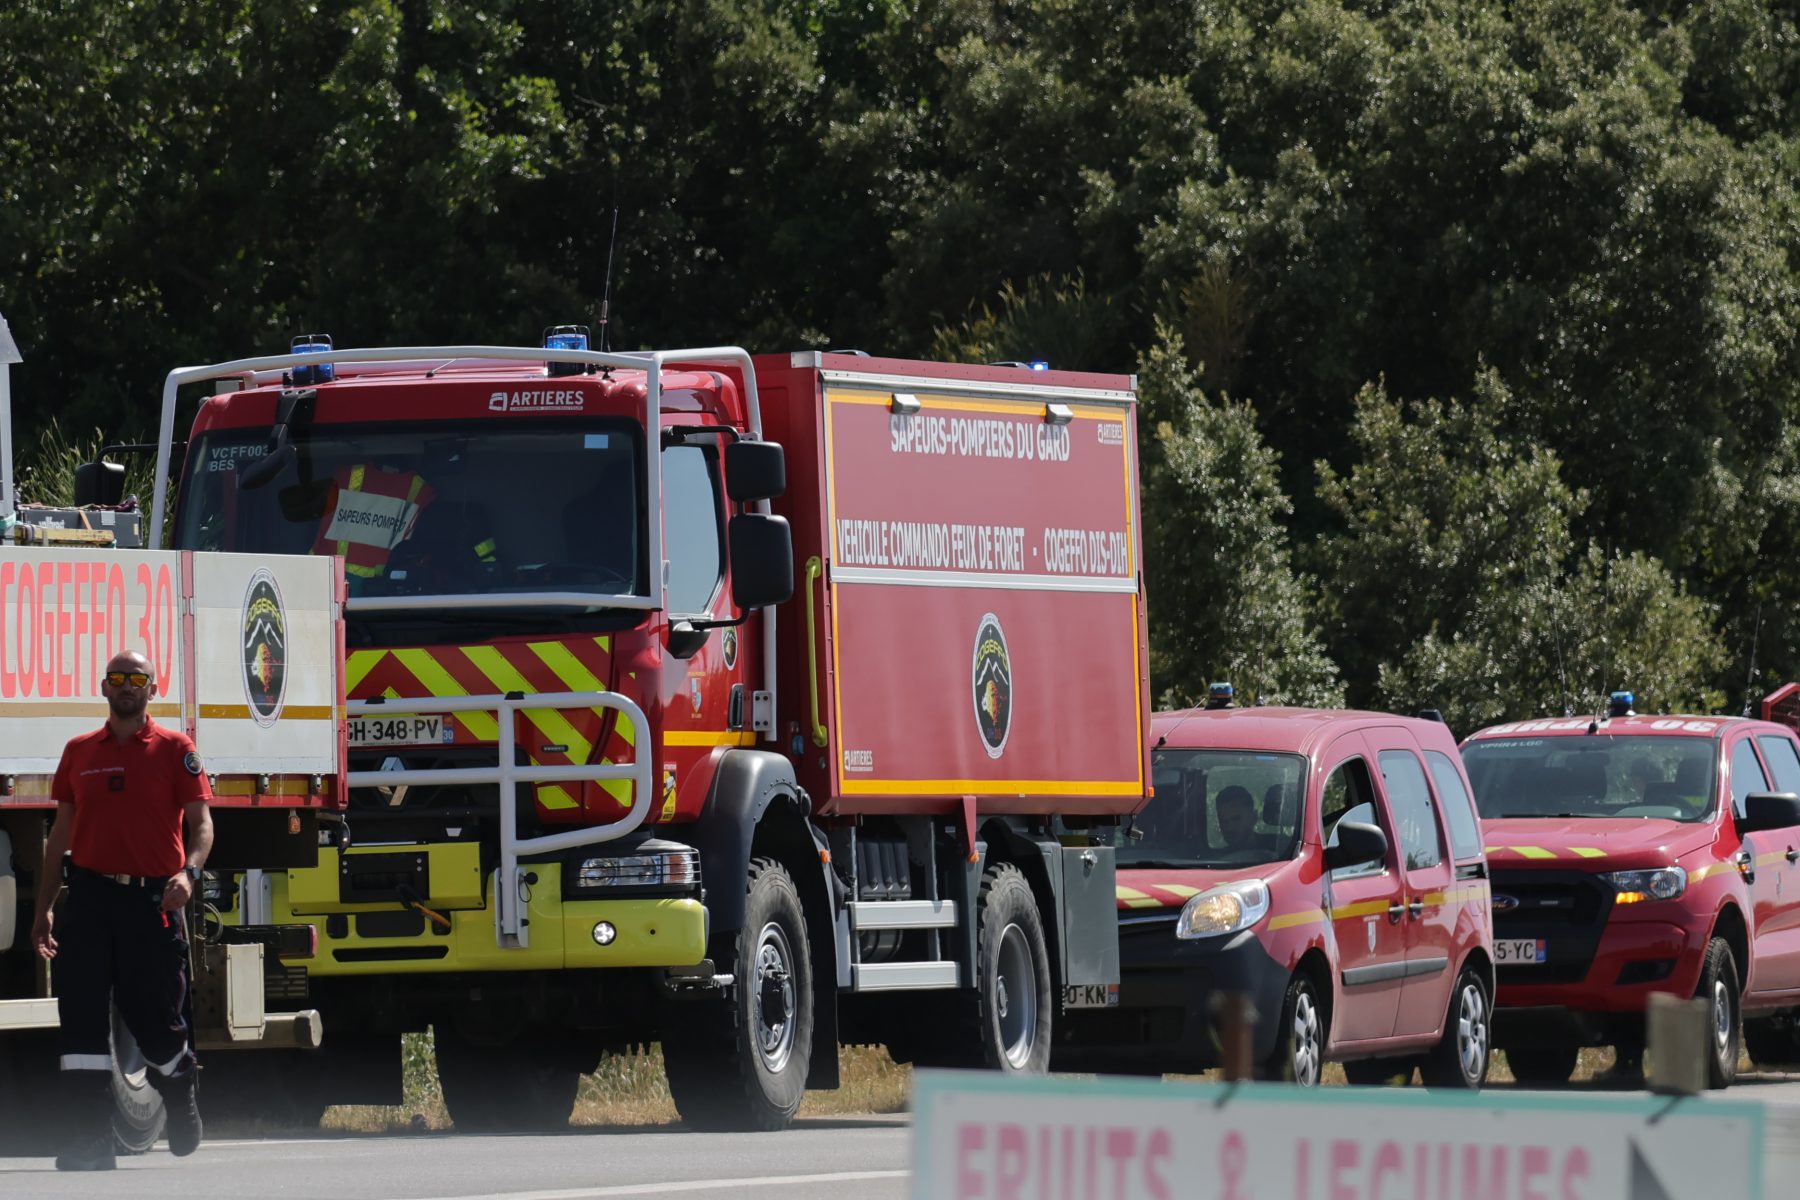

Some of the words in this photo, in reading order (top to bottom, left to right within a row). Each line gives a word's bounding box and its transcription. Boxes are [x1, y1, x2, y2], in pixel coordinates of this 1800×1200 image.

[510, 391, 584, 406] ARTIERES
[890, 415, 1014, 459] SAPEURS-POMPIERS
[1016, 422, 1034, 460] DU
[1036, 423, 1070, 461] GARD
[209, 459, 235, 471] BES
[337, 508, 372, 526] SAPEURS
[836, 518, 889, 565] VEHICULE
[890, 521, 950, 568] COMMANDO
[951, 524, 977, 569] FEUX
[978, 525, 993, 569] DE
[994, 526, 1025, 571] FORET
[1044, 527, 1088, 574] COGEFFO
[1089, 530, 1129, 574] DIS-DIH
[1, 561, 126, 698] COGEFFO
[137, 562, 173, 698] 30
[443, 730, 454, 740] 30
[1493, 942, 1534, 960] 5-YC
